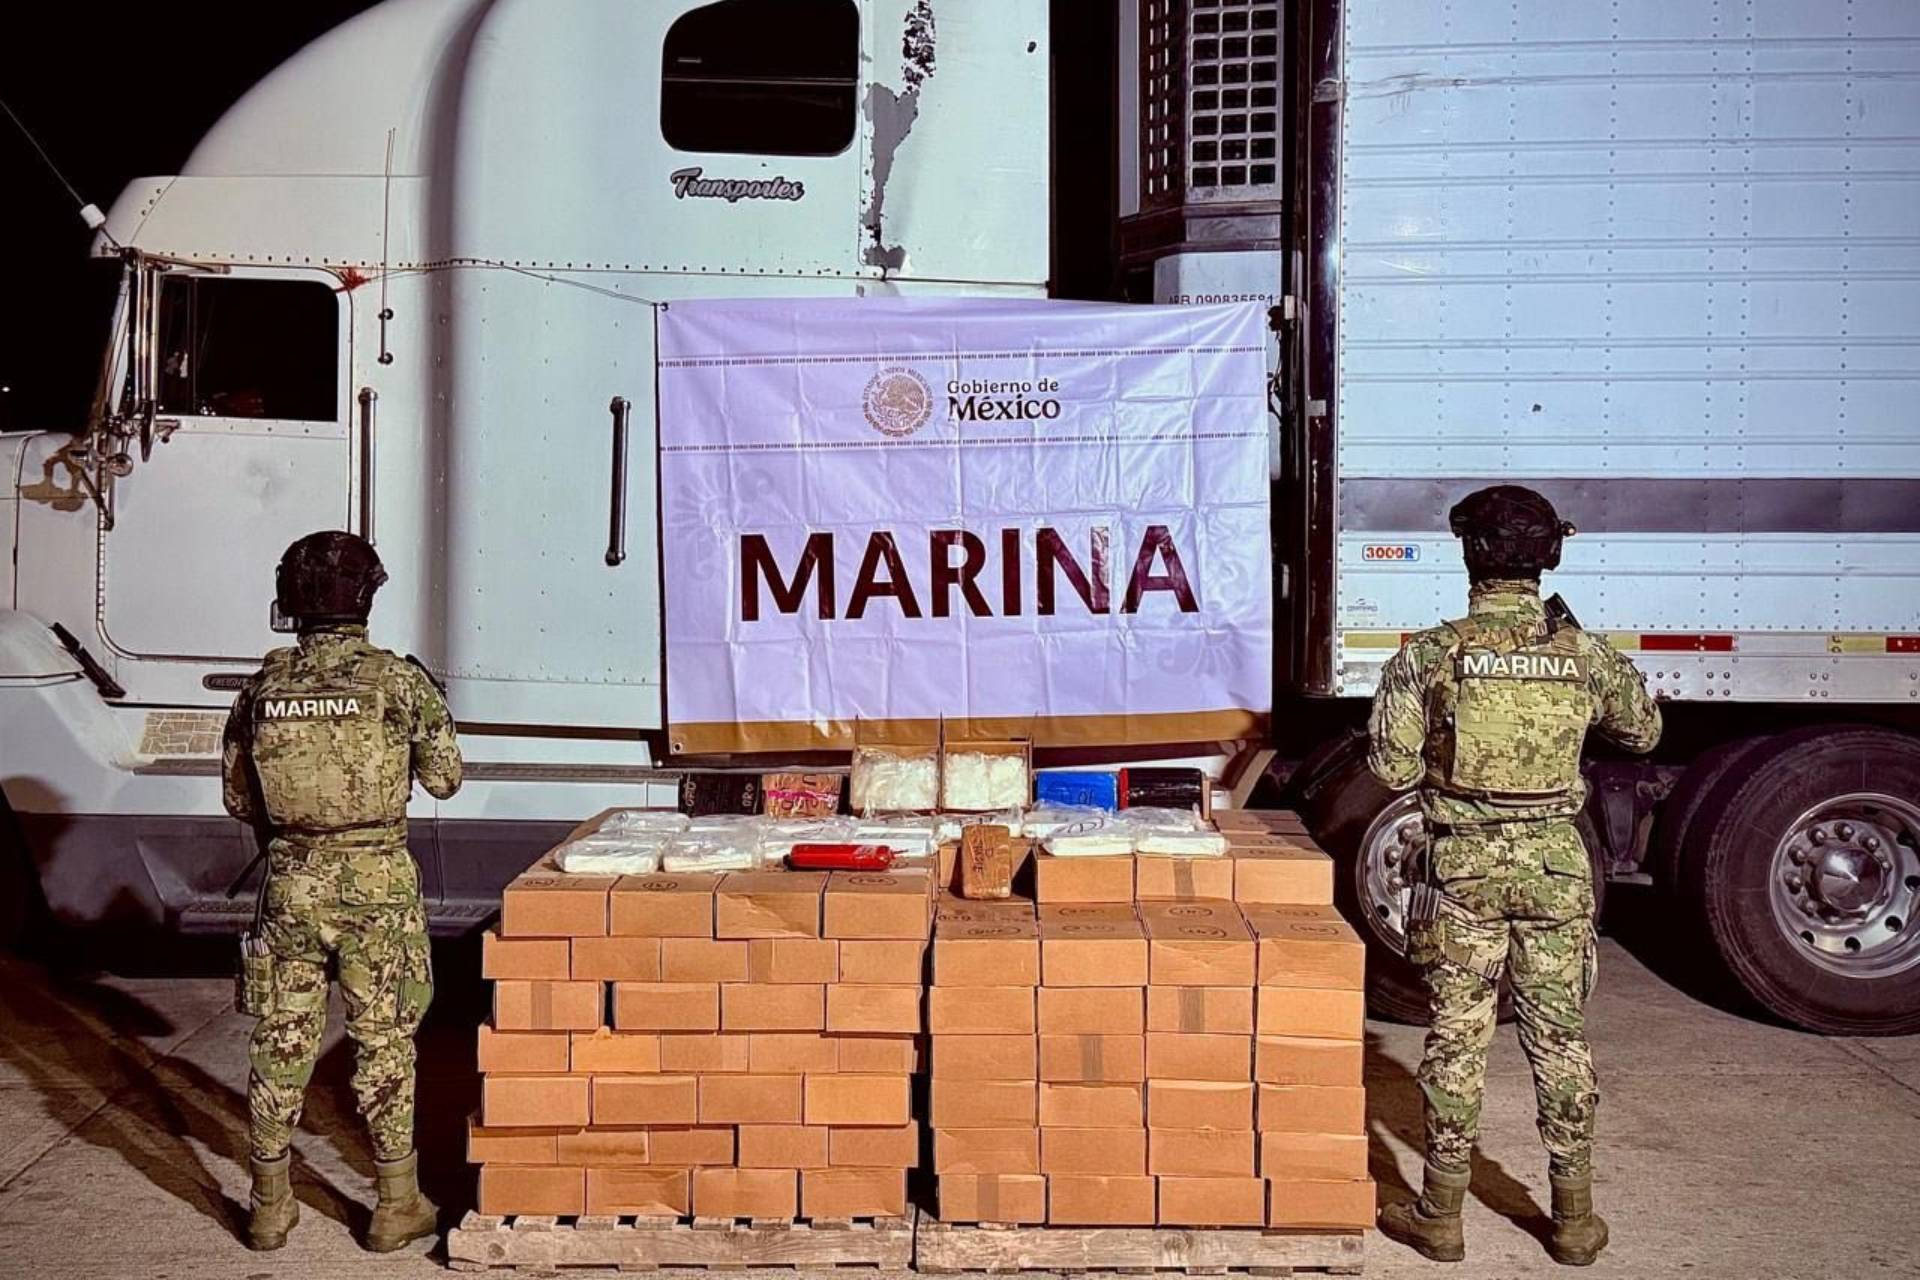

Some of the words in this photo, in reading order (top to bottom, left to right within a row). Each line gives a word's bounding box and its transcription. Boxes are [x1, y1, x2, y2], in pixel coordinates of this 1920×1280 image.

[670, 167, 805, 203] Transportes
[947, 379, 1032, 394] Gobierno
[1038, 378, 1059, 392] de
[947, 394, 1062, 421] México
[1366, 547, 1414, 559] 3000R
[740, 523, 1200, 622] MARINA
[1463, 654, 1580, 678] MARINA
[265, 698, 361, 718] MARINA
